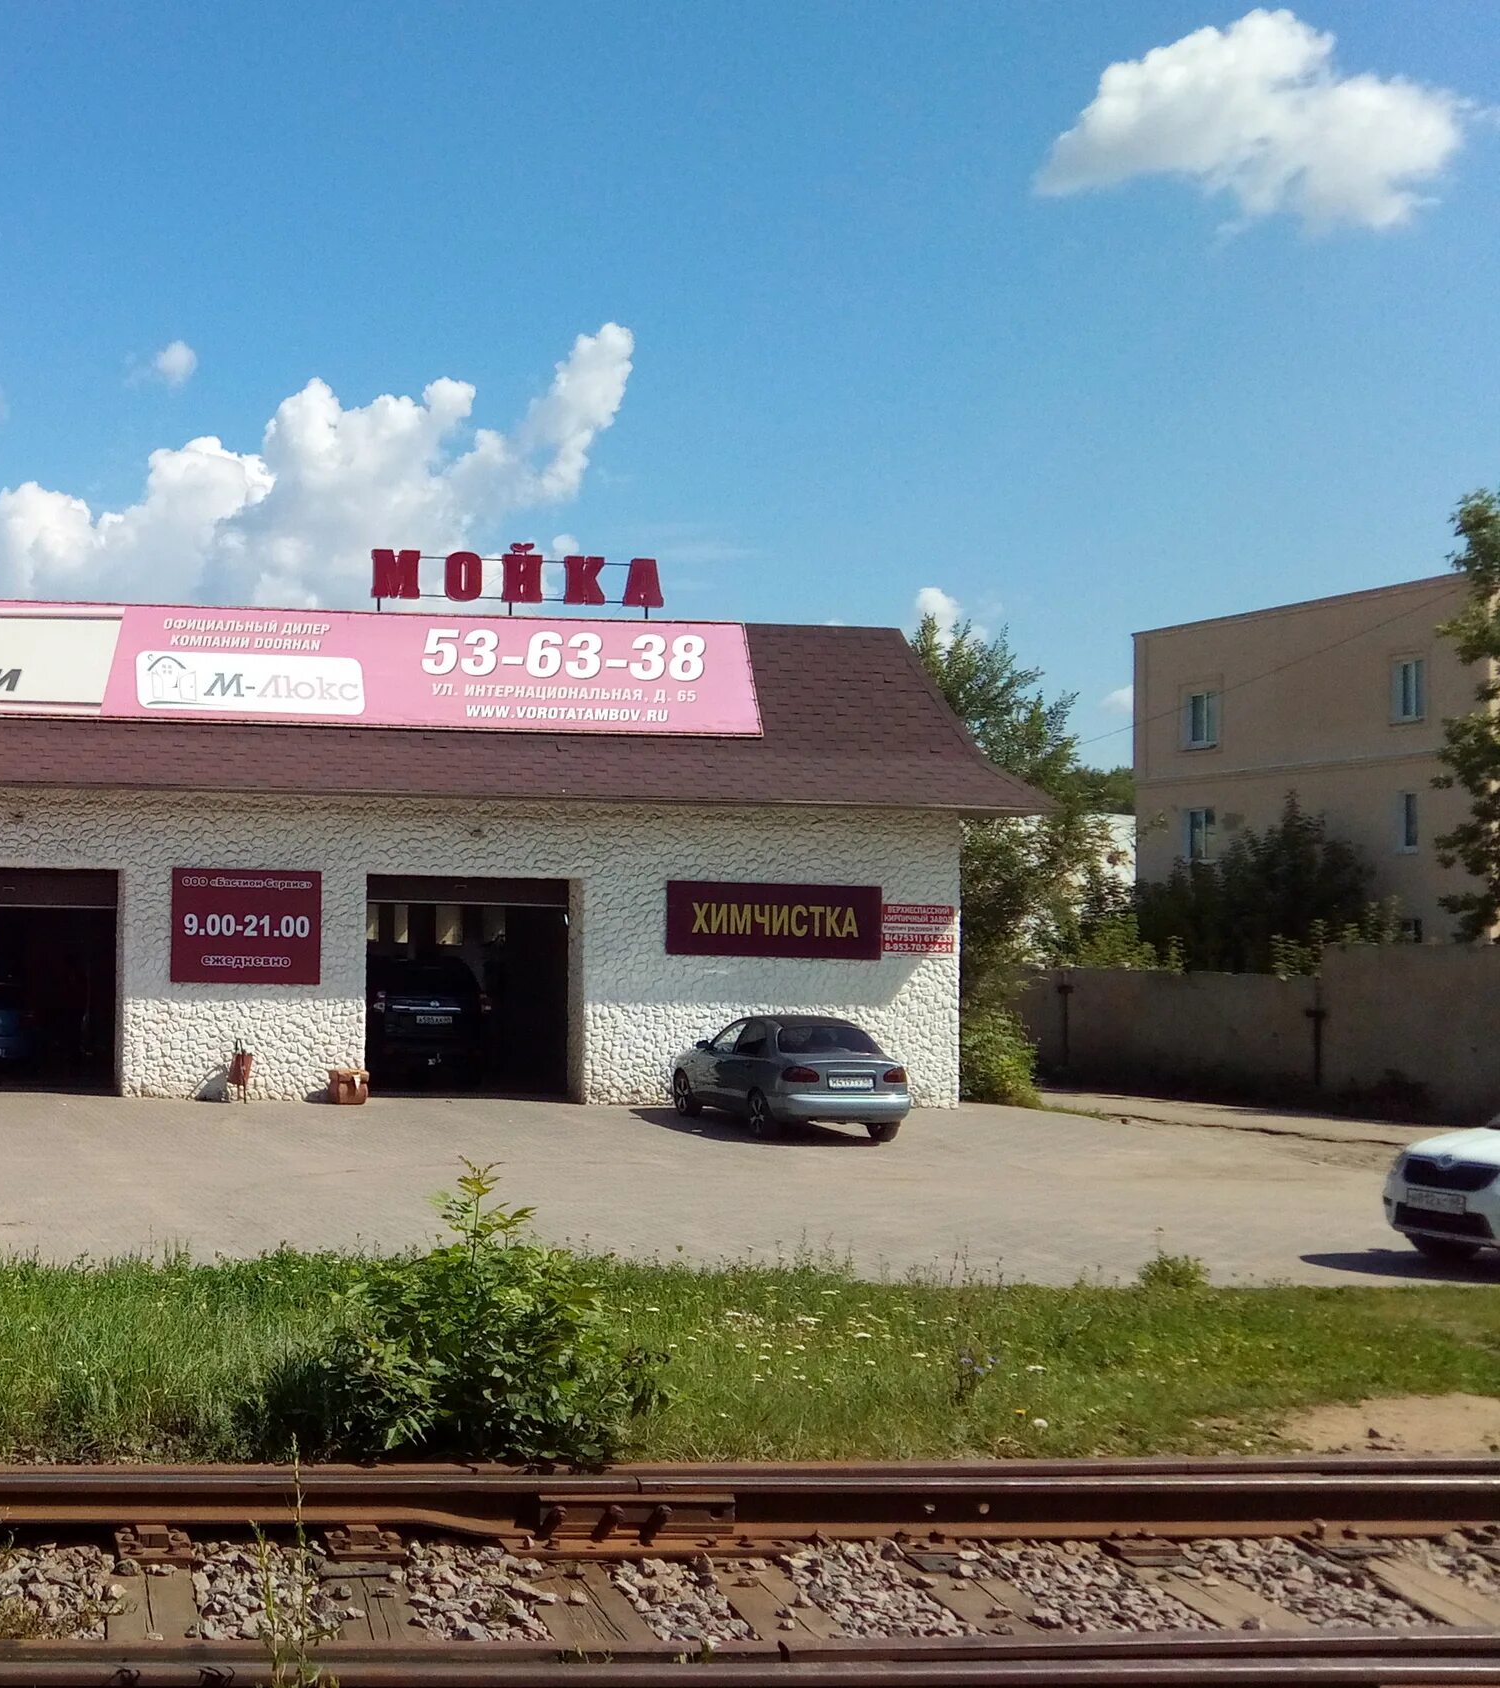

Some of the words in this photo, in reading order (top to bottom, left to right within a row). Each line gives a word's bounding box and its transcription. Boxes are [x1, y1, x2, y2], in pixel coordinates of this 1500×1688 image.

[371, 542, 665, 608] МОЙКА
[163, 618, 278, 634] ОФИЦИАЛЬНЫЙ
[281, 622, 331, 636] ДИЛЕР
[170, 634, 250, 648] КОМПАНИИ
[254, 637, 321, 651] DOORHAN
[421, 627, 707, 682] 53-63-38
[431, 682, 458, 697] УЛ.
[464, 684, 649, 702] ИНТЕРНАЦИОНАЛЬНАЯ,
[654, 689, 671, 703] Д.
[677, 689, 697, 703] 65
[466, 704, 669, 723] WWW.VOROTATAMBOV.RU
[181, 876, 208, 887] ООО
[183, 913, 310, 938] 9.00-21.00
[691, 902, 859, 938] ХИМЧИСТКА
[200, 954, 292, 968] ежедневно
